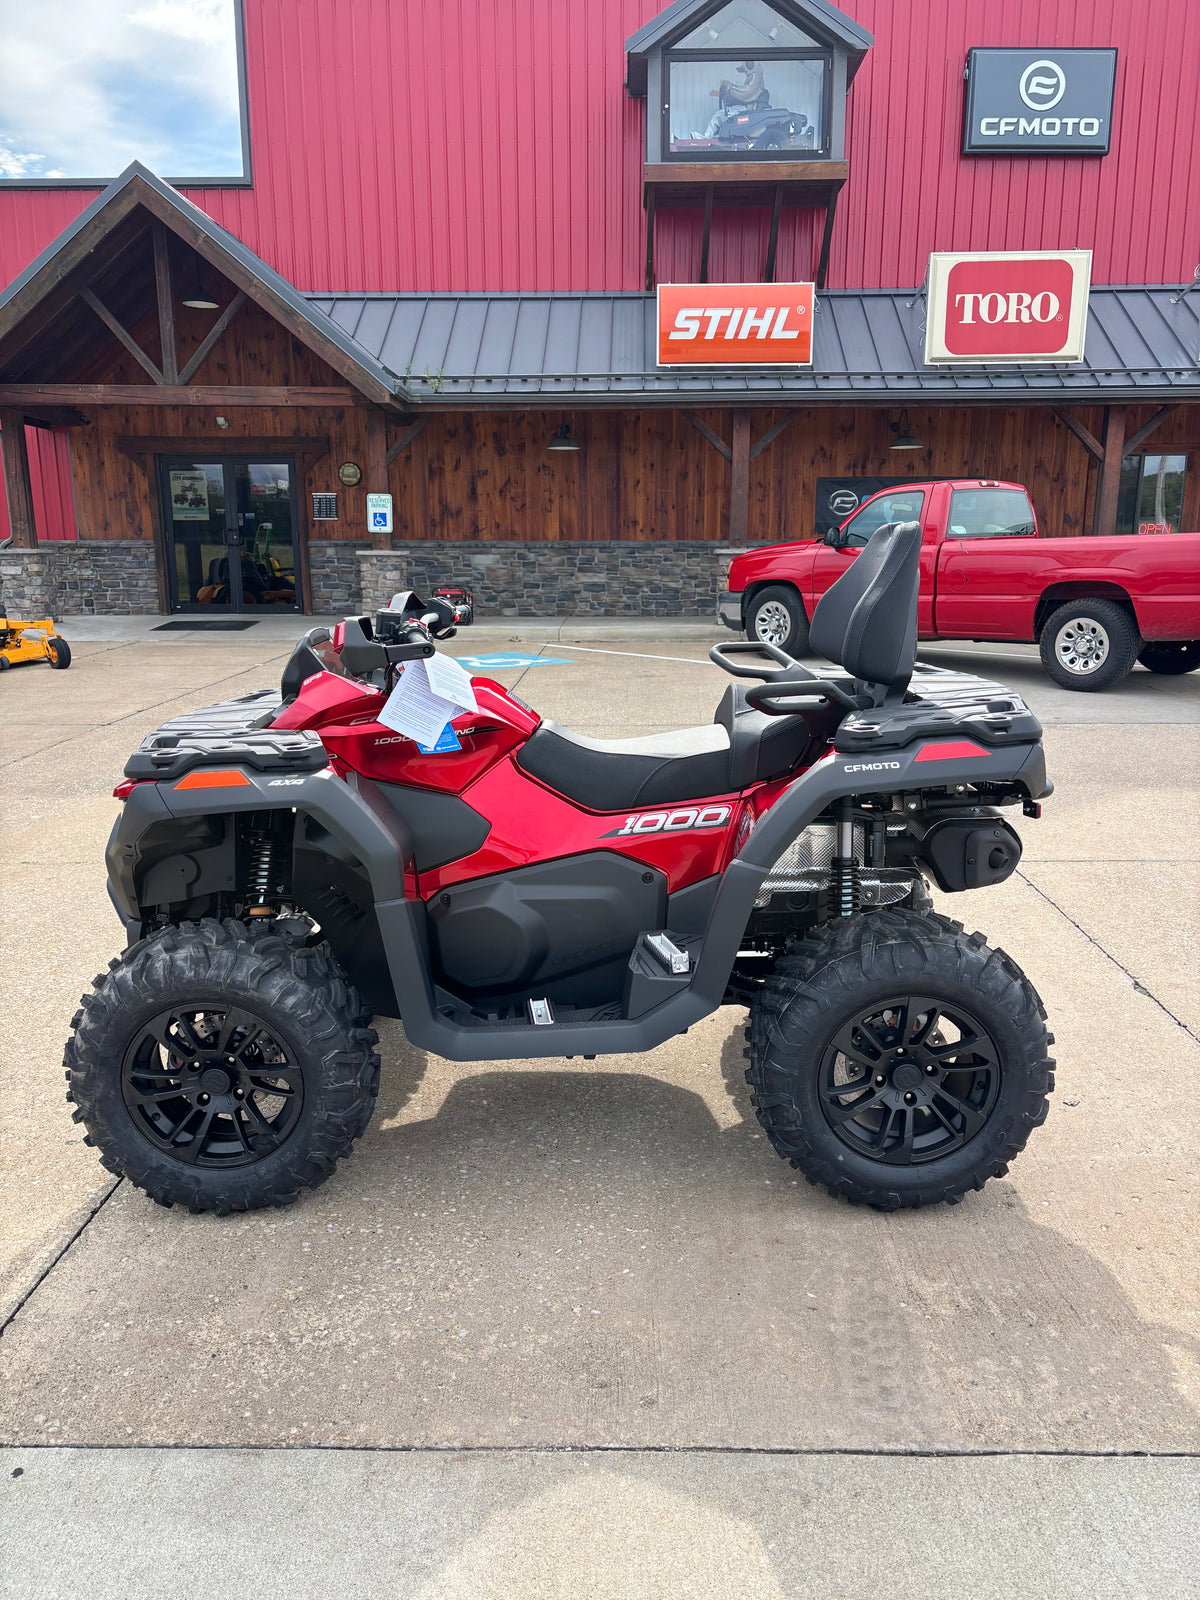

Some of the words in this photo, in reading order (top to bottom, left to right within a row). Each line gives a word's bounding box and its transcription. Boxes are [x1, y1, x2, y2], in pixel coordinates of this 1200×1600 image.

[980, 117, 1100, 136] CFMOTO
[955, 291, 1060, 324] TORO
[668, 307, 800, 340] STIHL
[1138, 523, 1171, 535] OPEN
[844, 762, 900, 772] CFMOTO
[618, 805, 732, 835] 1000
